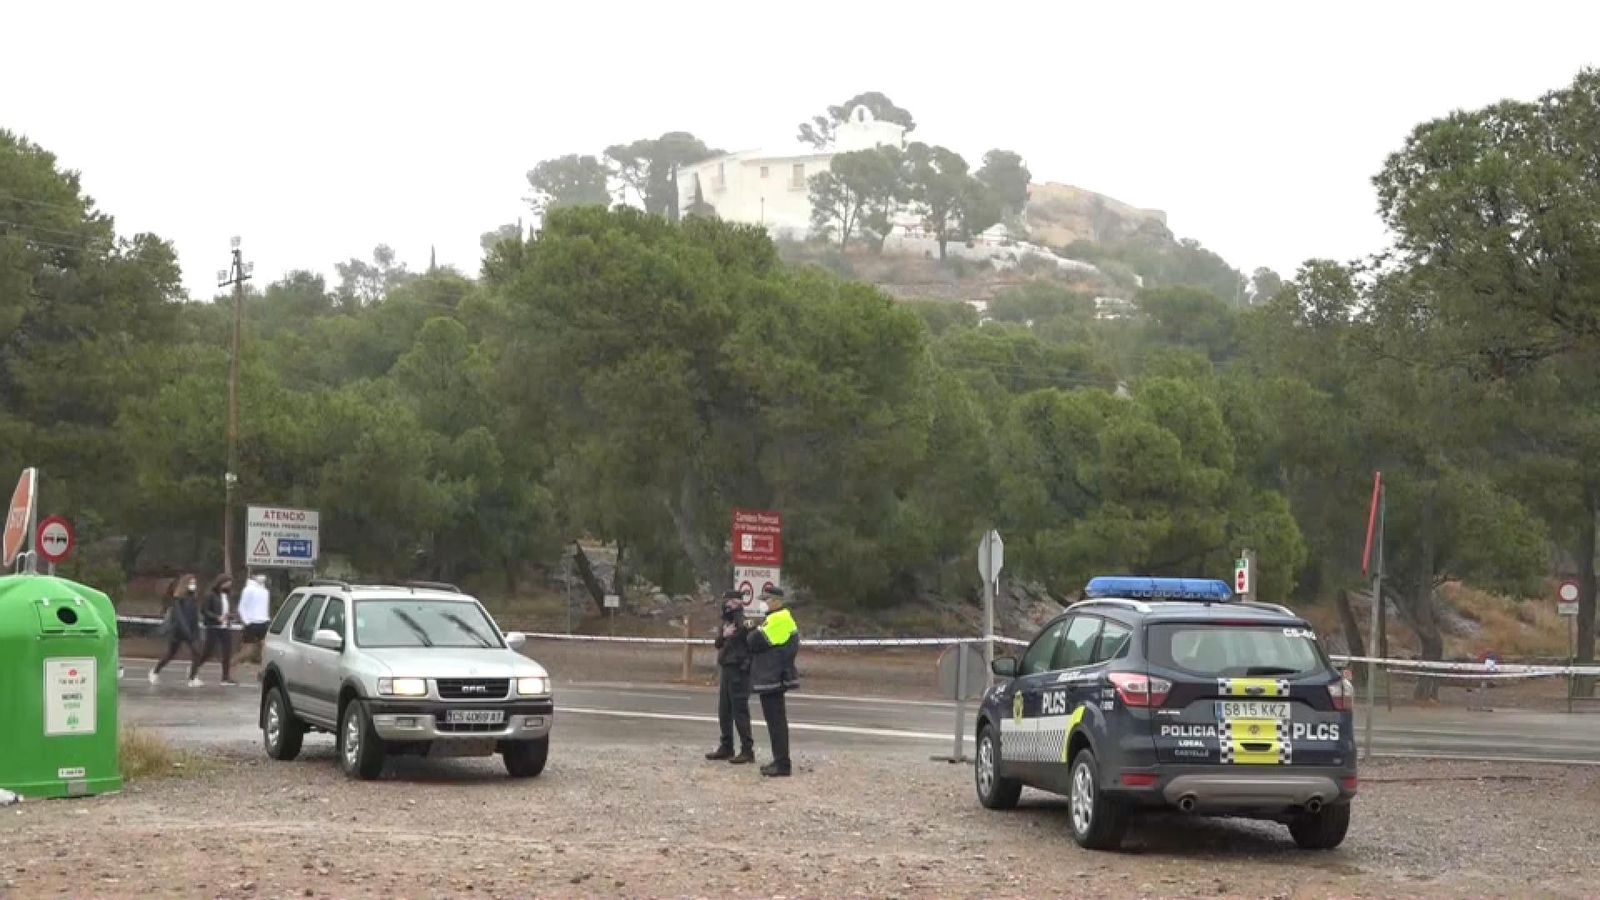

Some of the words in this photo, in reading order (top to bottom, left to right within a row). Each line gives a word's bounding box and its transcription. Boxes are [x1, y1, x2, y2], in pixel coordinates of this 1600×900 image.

[461, 685, 487, 693] OPEL
[1042, 691, 1066, 714] PLCS
[1225, 702, 1257, 716] 5815
[1259, 703, 1286, 717] KKZ
[1161, 725, 1216, 736] POLICIA
[1292, 723, 1339, 741] PLCS
[1178, 739, 1205, 747] LOCAL
